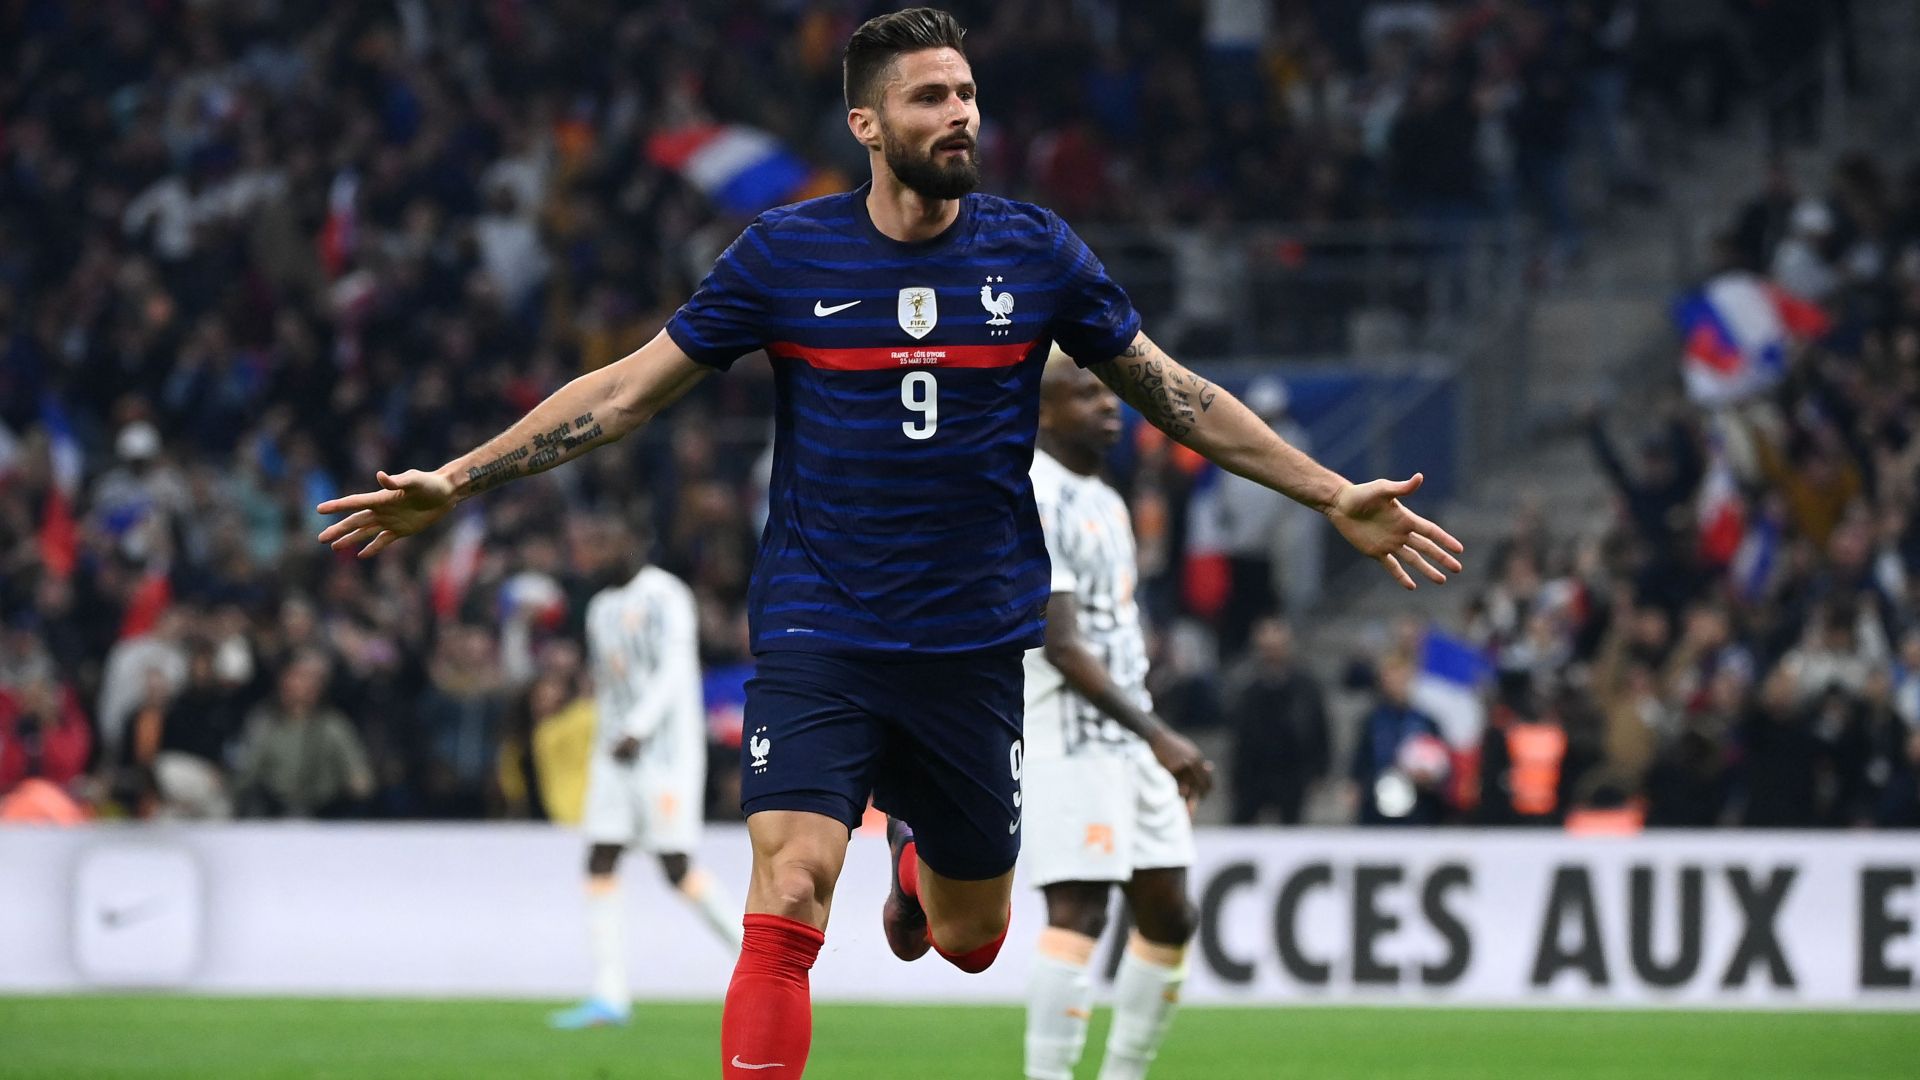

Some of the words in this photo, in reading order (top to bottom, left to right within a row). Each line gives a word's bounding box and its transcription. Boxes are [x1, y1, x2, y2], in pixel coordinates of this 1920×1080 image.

[901, 371, 938, 440] 9
[1010, 739, 1022, 808] 9
[1532, 864, 1798, 988] AUX
